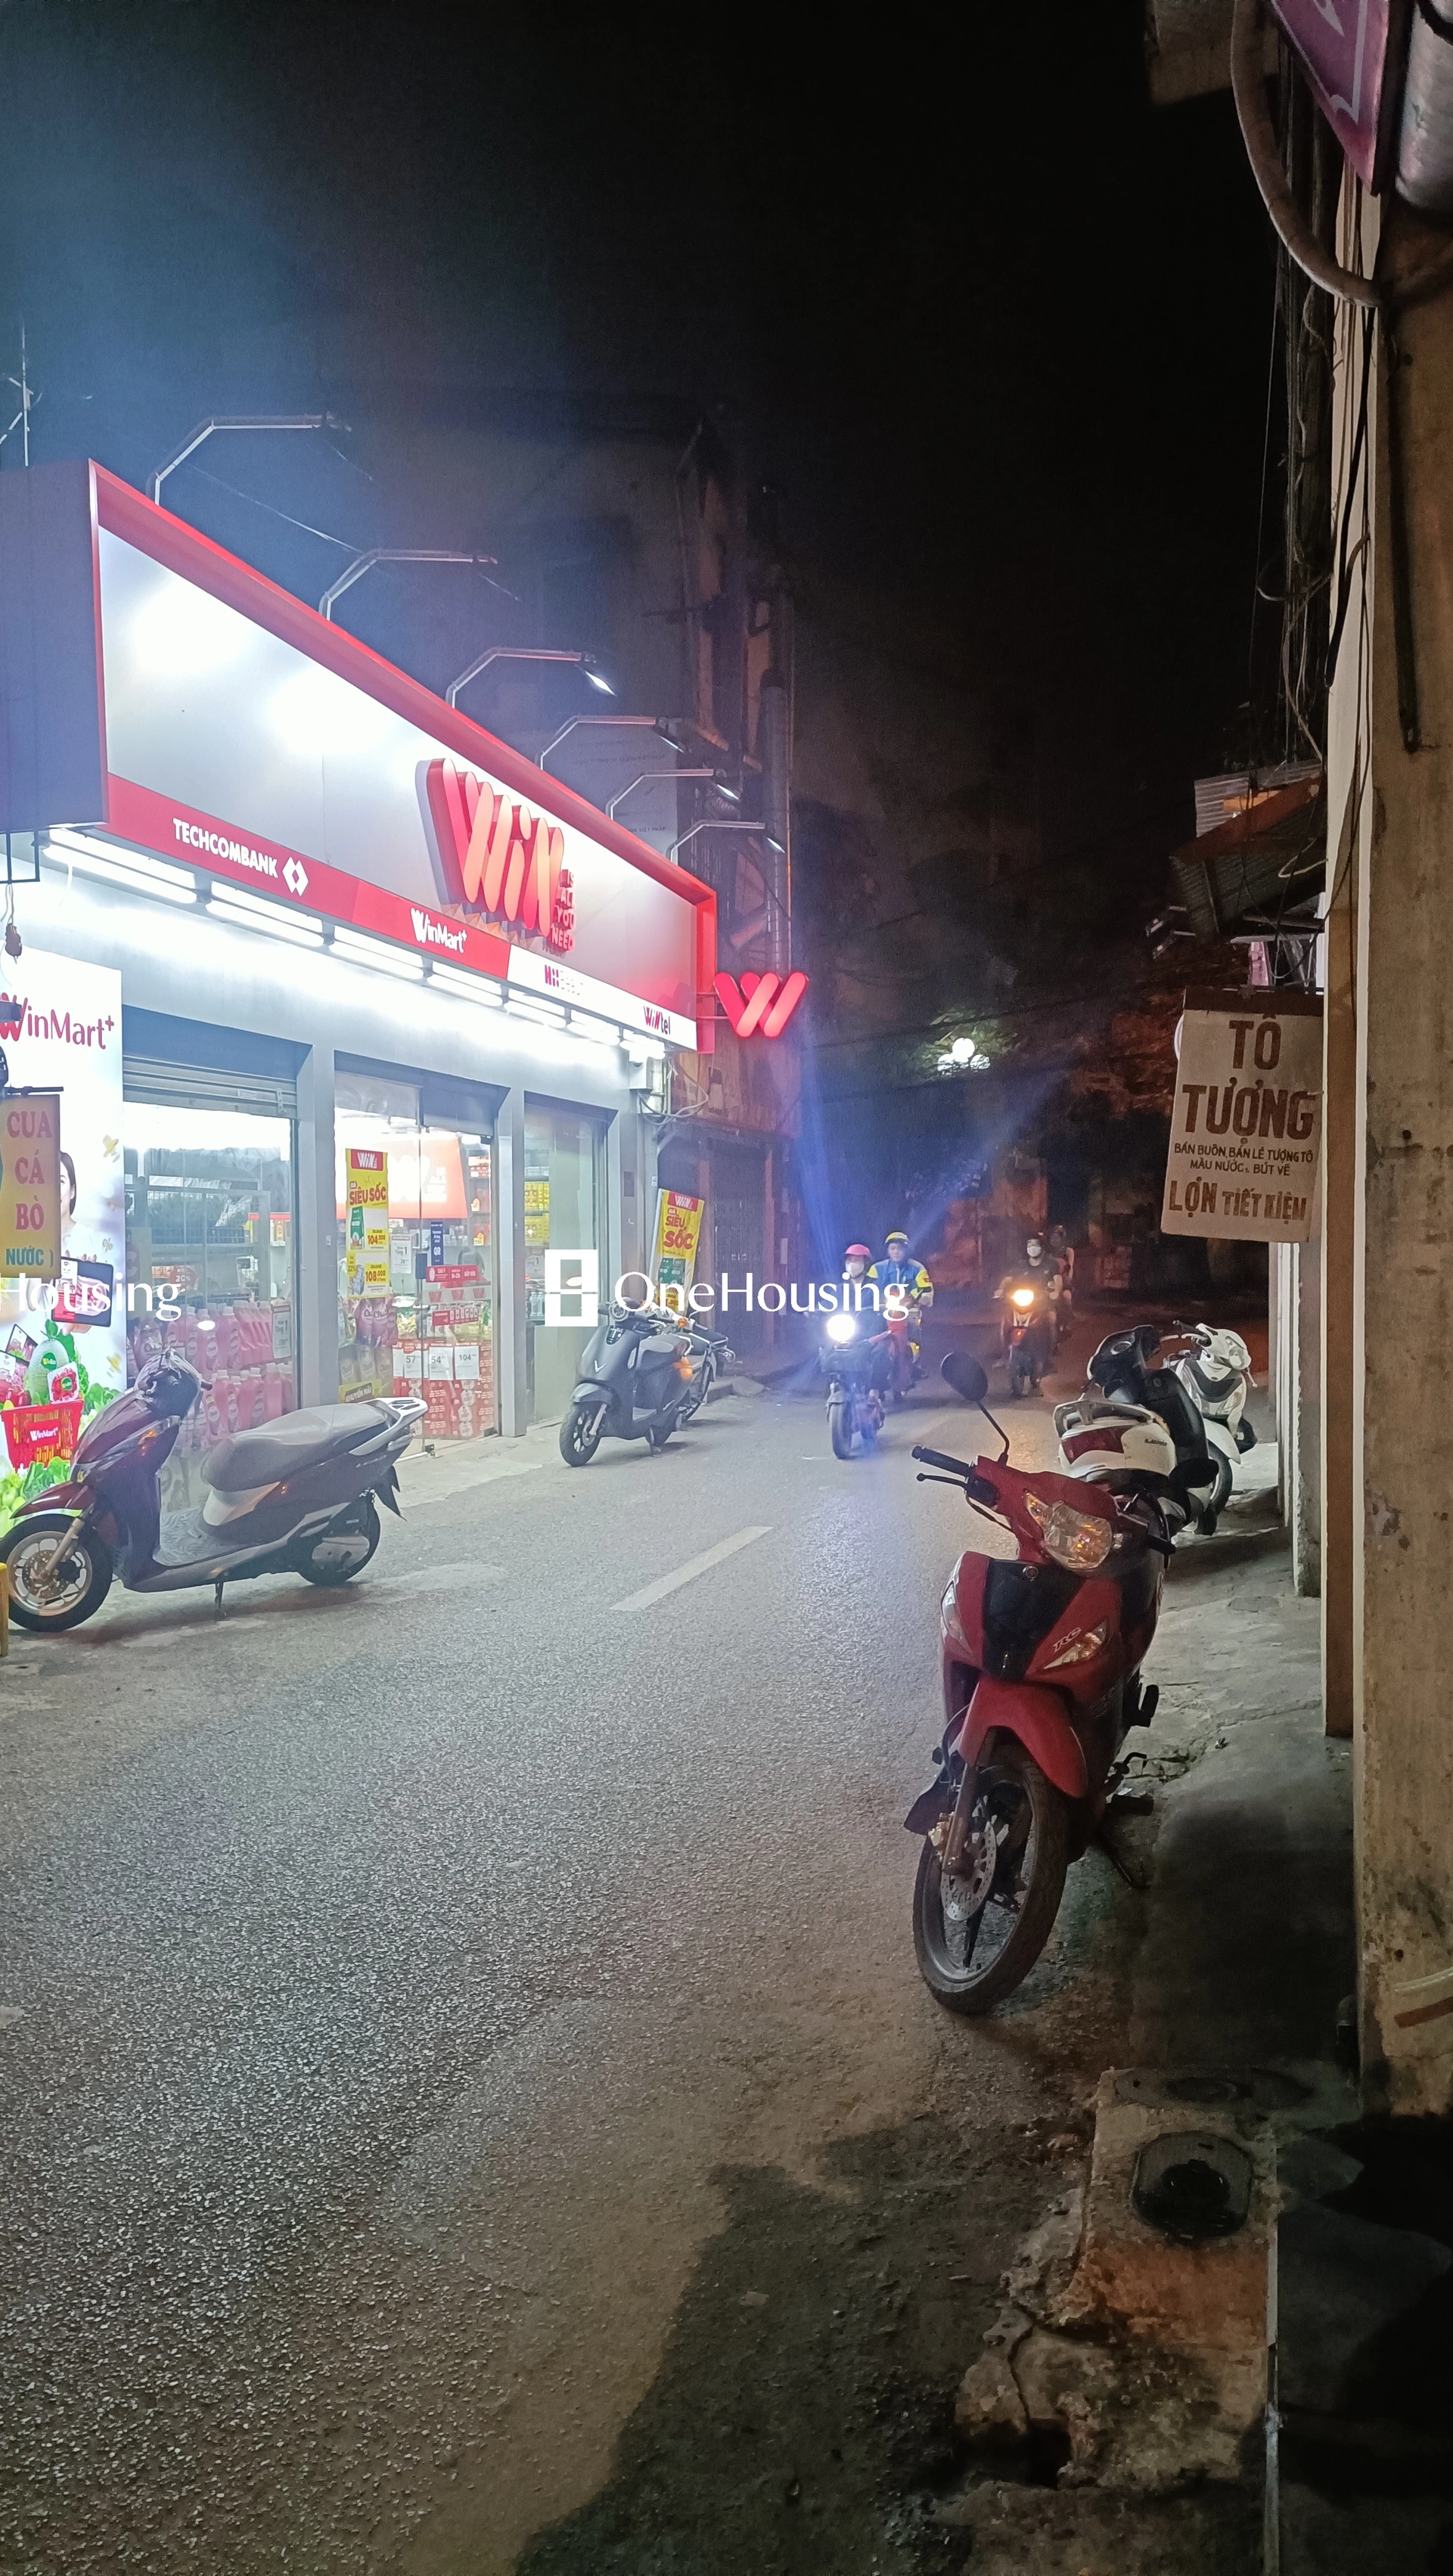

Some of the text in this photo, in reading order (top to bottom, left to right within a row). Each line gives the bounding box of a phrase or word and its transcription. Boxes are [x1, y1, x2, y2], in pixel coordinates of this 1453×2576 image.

[172, 817, 278, 879] TECHCOMBANK
[560, 886, 576, 908] ALL
[554, 905, 576, 930] YOU
[550, 922, 576, 952] NEED
[1228, 1013, 1282, 1070] TÔ
[1181, 1076, 1316, 1144] TƯỢNG
[6, 1110, 53, 1139] CUA
[1174, 1141, 1196, 1155] BÁN
[1228, 1144, 1250, 1159] BÁN
[1267, 1148, 1299, 1163] TƯỢNG
[1300, 1149, 1314, 1163] TÔ
[14, 1149, 45, 1184] CÁ
[1253, 1162, 1274, 1175] BÚT
[349, 1181, 387, 1206] SIÊU SỐC
[1169, 1176, 1307, 1224] LỢN TIẾT KIỆM
[15, 1194, 45, 1231] BÒ
[665, 1214, 685, 1228] SIÊU
[663, 1226, 694, 1250] SỐC
[5, 1245, 45, 1267] NƯỚC
[405, 1355, 416, 1364] 57
[431, 1355, 442, 1364] 54
